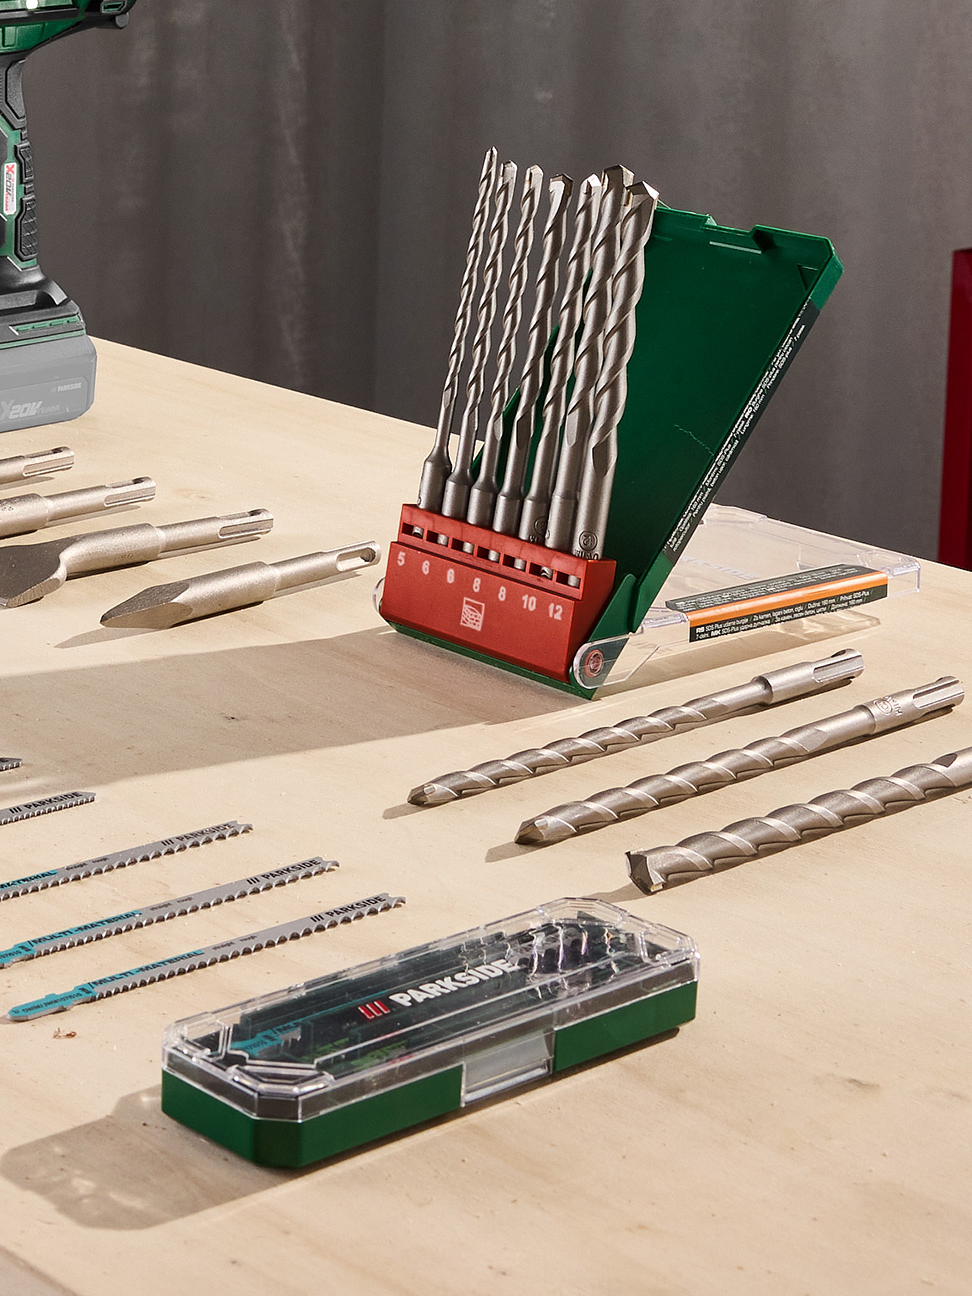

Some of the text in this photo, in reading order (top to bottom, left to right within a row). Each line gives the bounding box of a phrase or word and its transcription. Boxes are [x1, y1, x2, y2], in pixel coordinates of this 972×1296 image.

[57, 382, 82, 393] PARKSIDE
[397, 552, 563, 620] 5 6 6 8 8 10 12
[24, 790, 82, 811] PARKSIDE
[176, 821, 234, 843] PARKSIDE
[263, 857, 321, 880] PARKSIDE
[93, 948, 203, 987] MULTI-MATERIAL
[326, 894, 386, 918] PARKSIDE
[389, 959, 519, 1007] PARKSIDE
